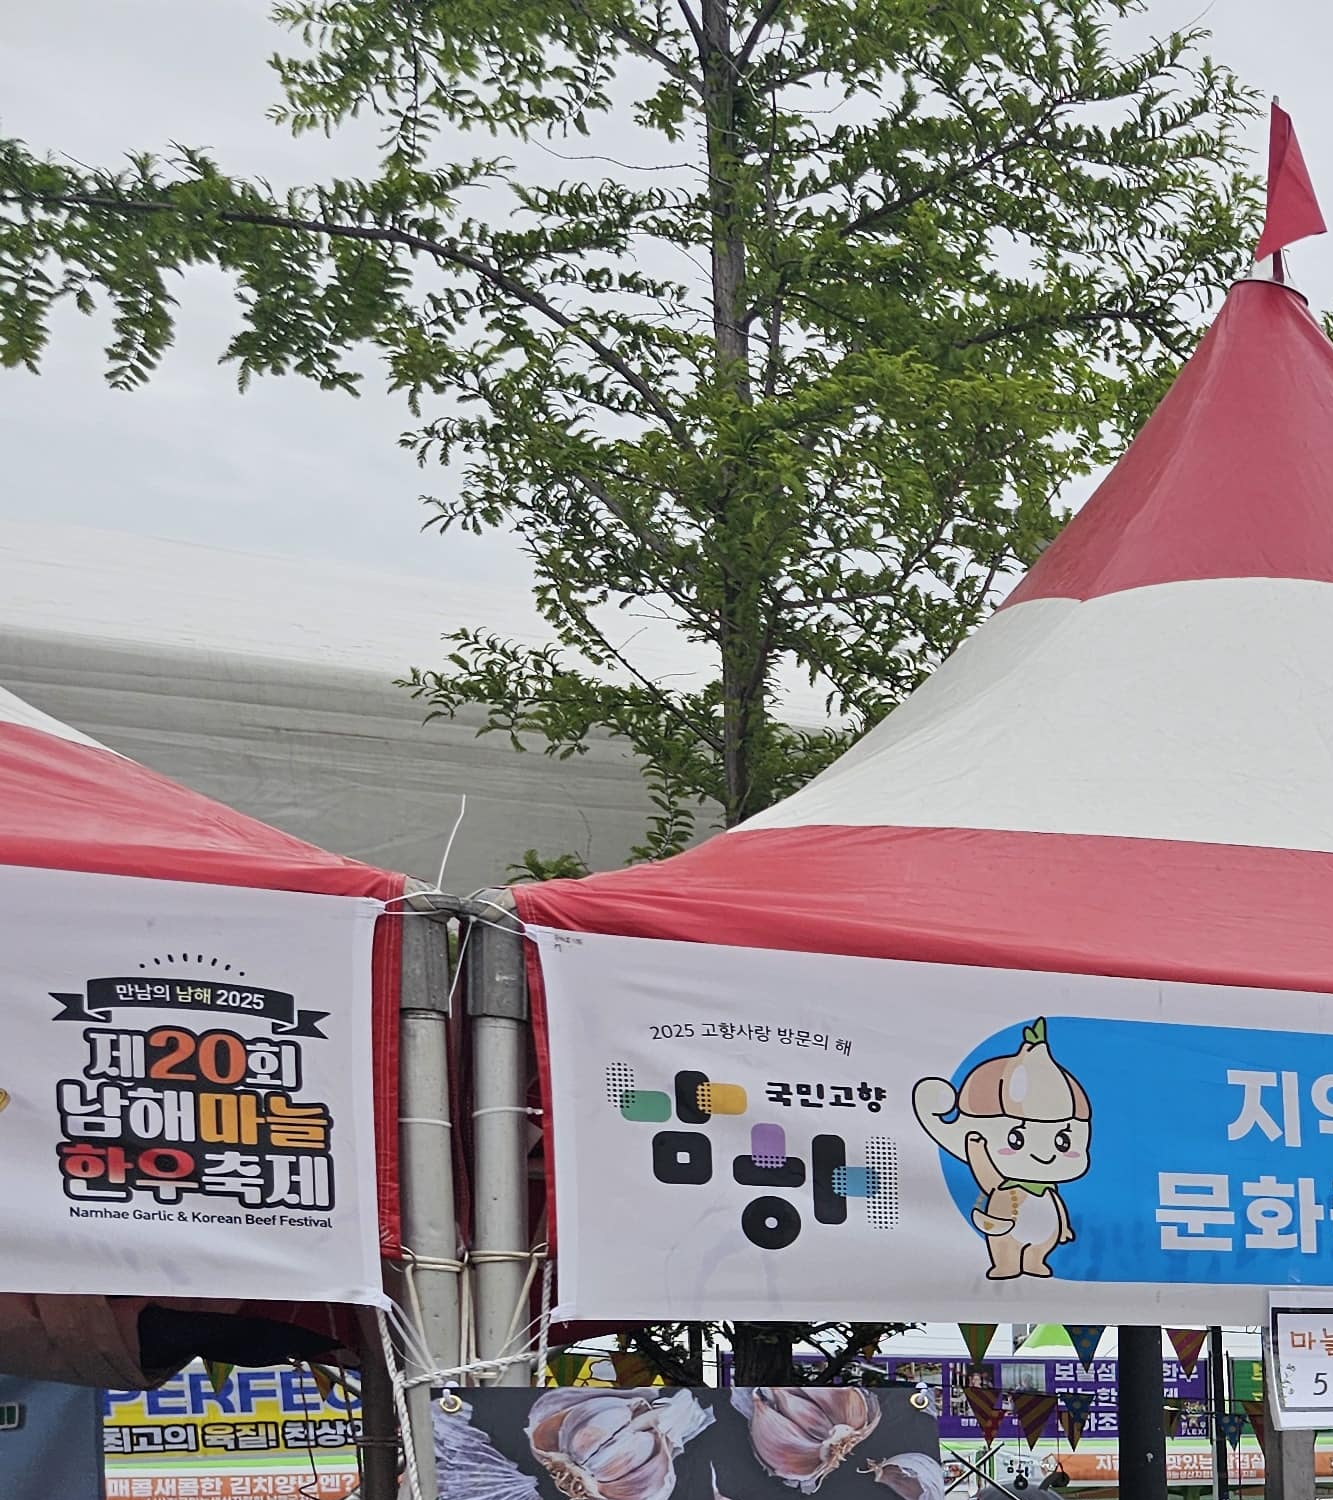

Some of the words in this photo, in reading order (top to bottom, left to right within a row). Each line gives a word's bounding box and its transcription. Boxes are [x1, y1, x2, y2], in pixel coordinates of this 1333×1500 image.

[116, 982, 170, 1002] 만남의
[175, 985, 211, 1005] 남해
[216, 989, 265, 1011] 2025
[649, 1023, 695, 1041] 2025
[701, 1021, 772, 1044] 고향사랑
[777, 1026, 830, 1050] 방문의
[835, 1036, 853, 1057] 해
[87, 1028, 298, 1090] 제20회
[765, 1080, 888, 1114] 국민고향
[60, 1082, 330, 1150] 남해마늘
[61, 1143, 332, 1208] 한우축제
[69, 1206, 129, 1220] Namhae
[133, 1208, 174, 1223] Garlic
[177, 1210, 188, 1222] &
[191, 1211, 242, 1225] Korean
[245, 1213, 277, 1226] Beef
[279, 1214, 332, 1229] Festival
[103, 1423, 198, 1452] 최고의
[203, 1422, 278, 1450] 육질!
[107, 1477, 223, 1498] 매콤새콤한
[230, 1473, 357, 1496] 김치양념엔?
